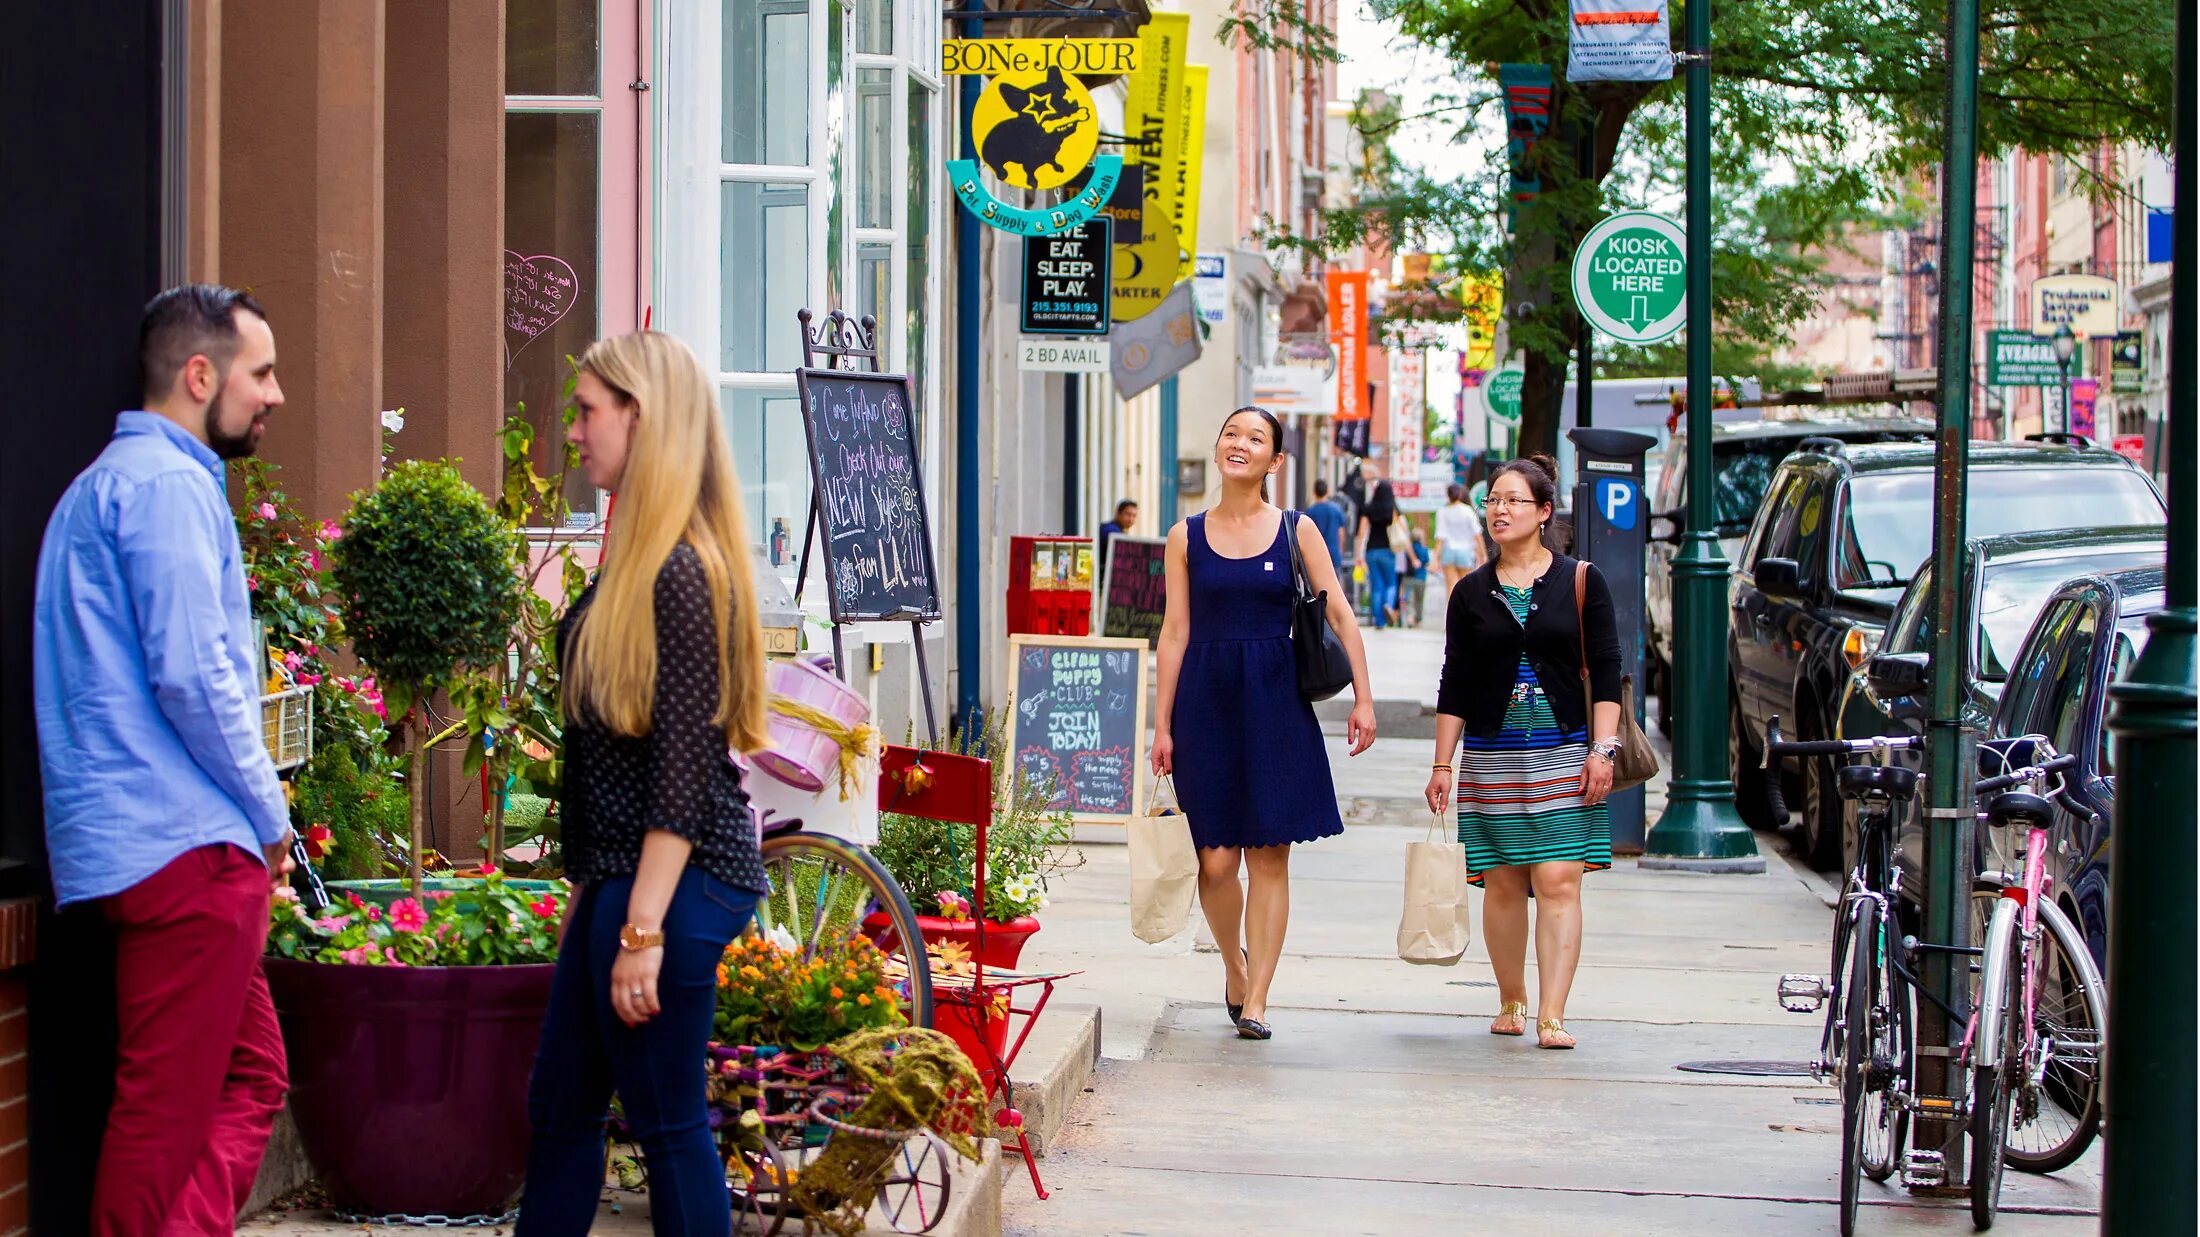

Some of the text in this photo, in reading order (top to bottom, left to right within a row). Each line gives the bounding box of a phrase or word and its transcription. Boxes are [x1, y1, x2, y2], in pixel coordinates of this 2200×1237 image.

[942, 43, 1137, 71] BONe JOUR
[1141, 113, 1164, 200] SWEAT
[959, 179, 979, 208] Pet
[981, 201, 1029, 232] Supply
[1050, 208, 1083, 228] Dog
[1080, 174, 1114, 210] Wash
[1046, 223, 1089, 239] IVE.
[1049, 242, 1084, 258] EAT.
[1608, 237, 1669, 255] KIOSK
[1037, 260, 1096, 278] SLEEP.
[1594, 257, 1683, 275] LOCATED
[1043, 280, 1088, 297] PLAY.
[1112, 287, 1161, 298] ARTER
[1612, 275, 1664, 292] HERE
[1032, 301, 1099, 312] 215.351.9193
[1025, 348, 1102, 363] 2 BD AVAIL
[1490, 384, 1521, 393] LOCAT
[839, 443, 869, 483] Check
[824, 476, 866, 528] NEW
[1607, 483, 1632, 520] P
[1051, 652, 1100, 669] CLEAN
[1052, 668, 1102, 686] PUPPY
[1048, 710, 1100, 731] JOIN
[1047, 731, 1101, 750] TODAY!
